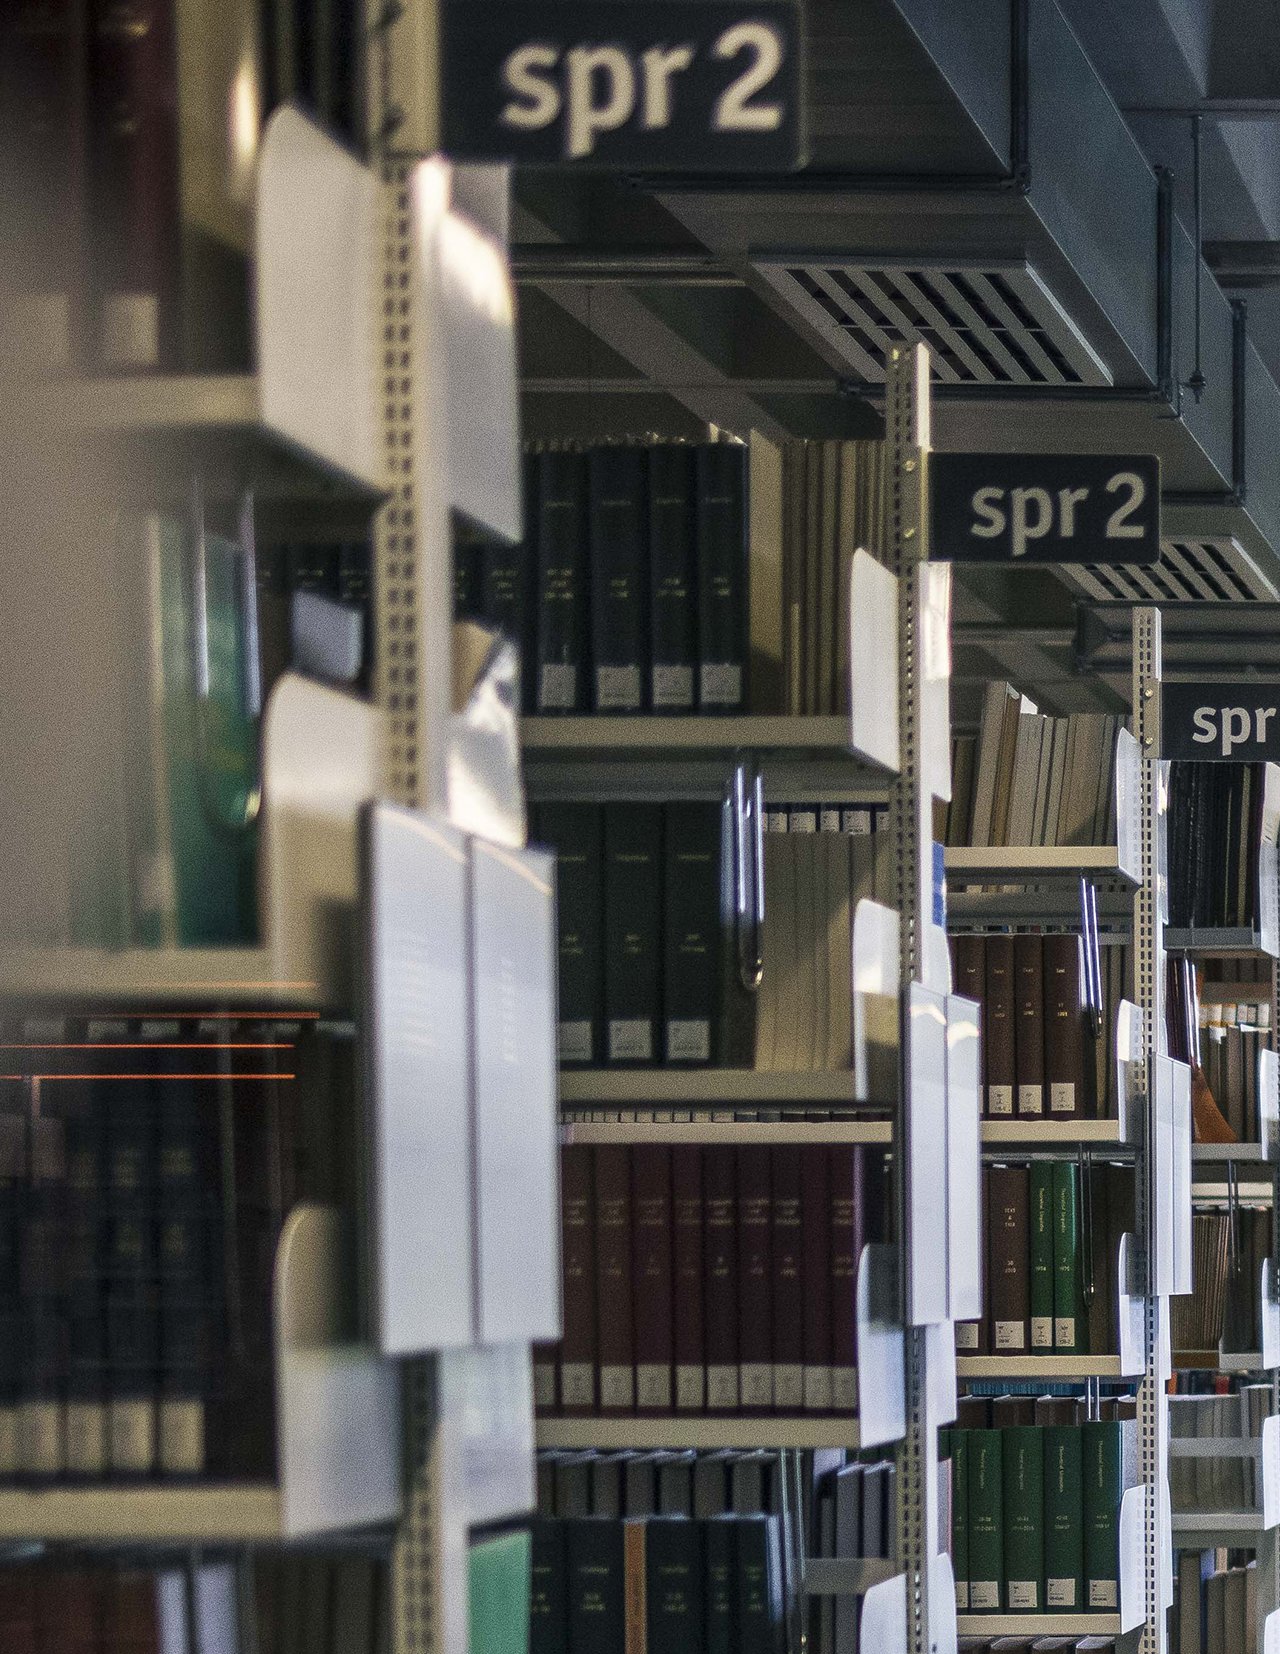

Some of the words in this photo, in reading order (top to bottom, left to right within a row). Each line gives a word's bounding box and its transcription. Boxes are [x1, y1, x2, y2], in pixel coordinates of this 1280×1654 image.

[500, 44, 695, 156] spr
[712, 20, 782, 131] 2
[970, 486, 1090, 557] spr
[1105, 471, 1145, 538] 2
[1192, 706, 1277, 756] spr
